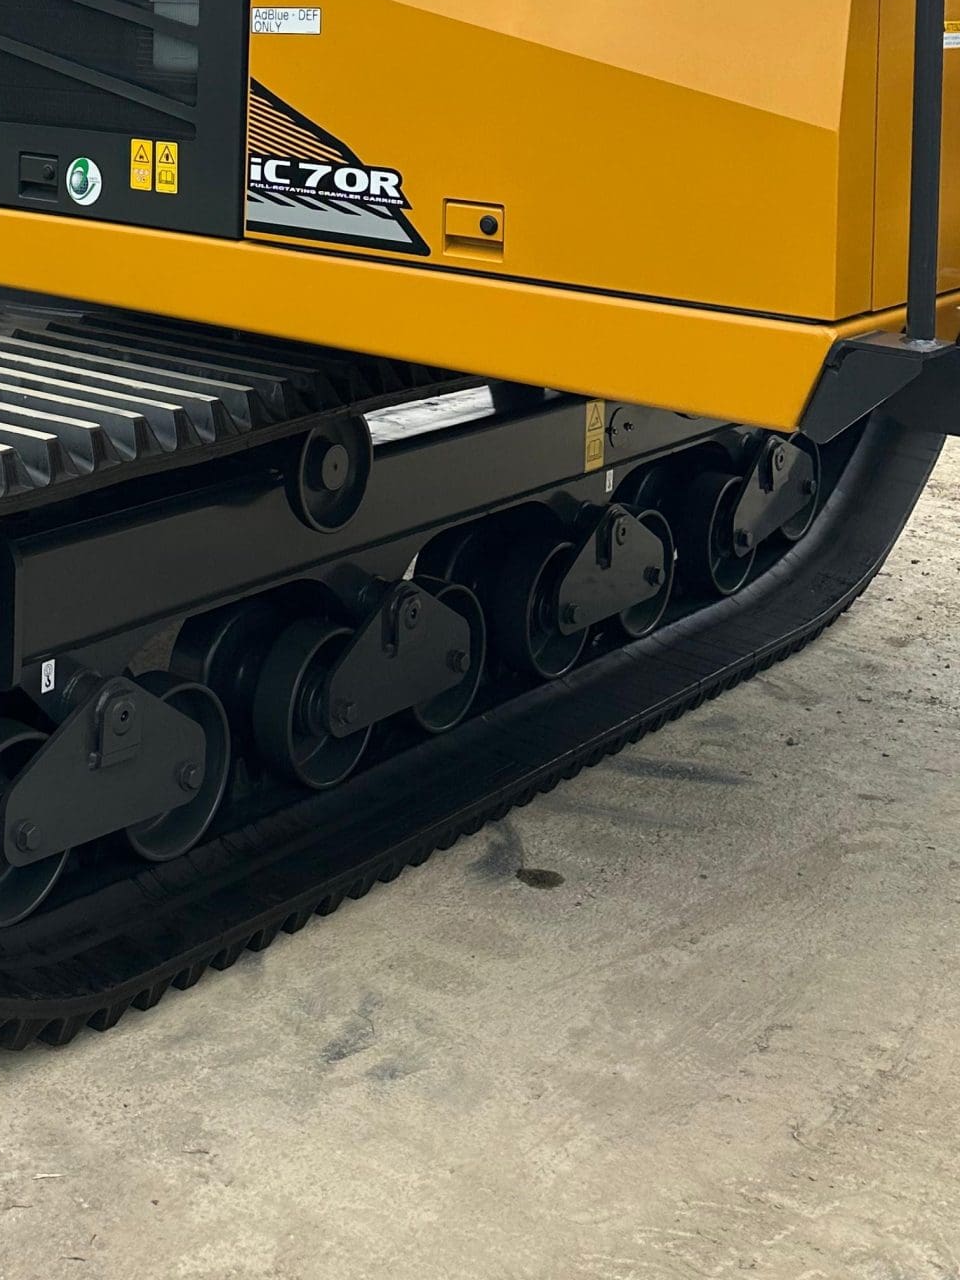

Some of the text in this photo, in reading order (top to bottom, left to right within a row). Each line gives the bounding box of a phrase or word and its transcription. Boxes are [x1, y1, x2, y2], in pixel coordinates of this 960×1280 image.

[254, 8, 289, 21] AdBlue
[298, 8, 319, 21] DEF
[254, 21, 282, 32] ONLY
[318, 190, 361, 201] CRAWLER
[362, 195, 404, 206] CARRIER
